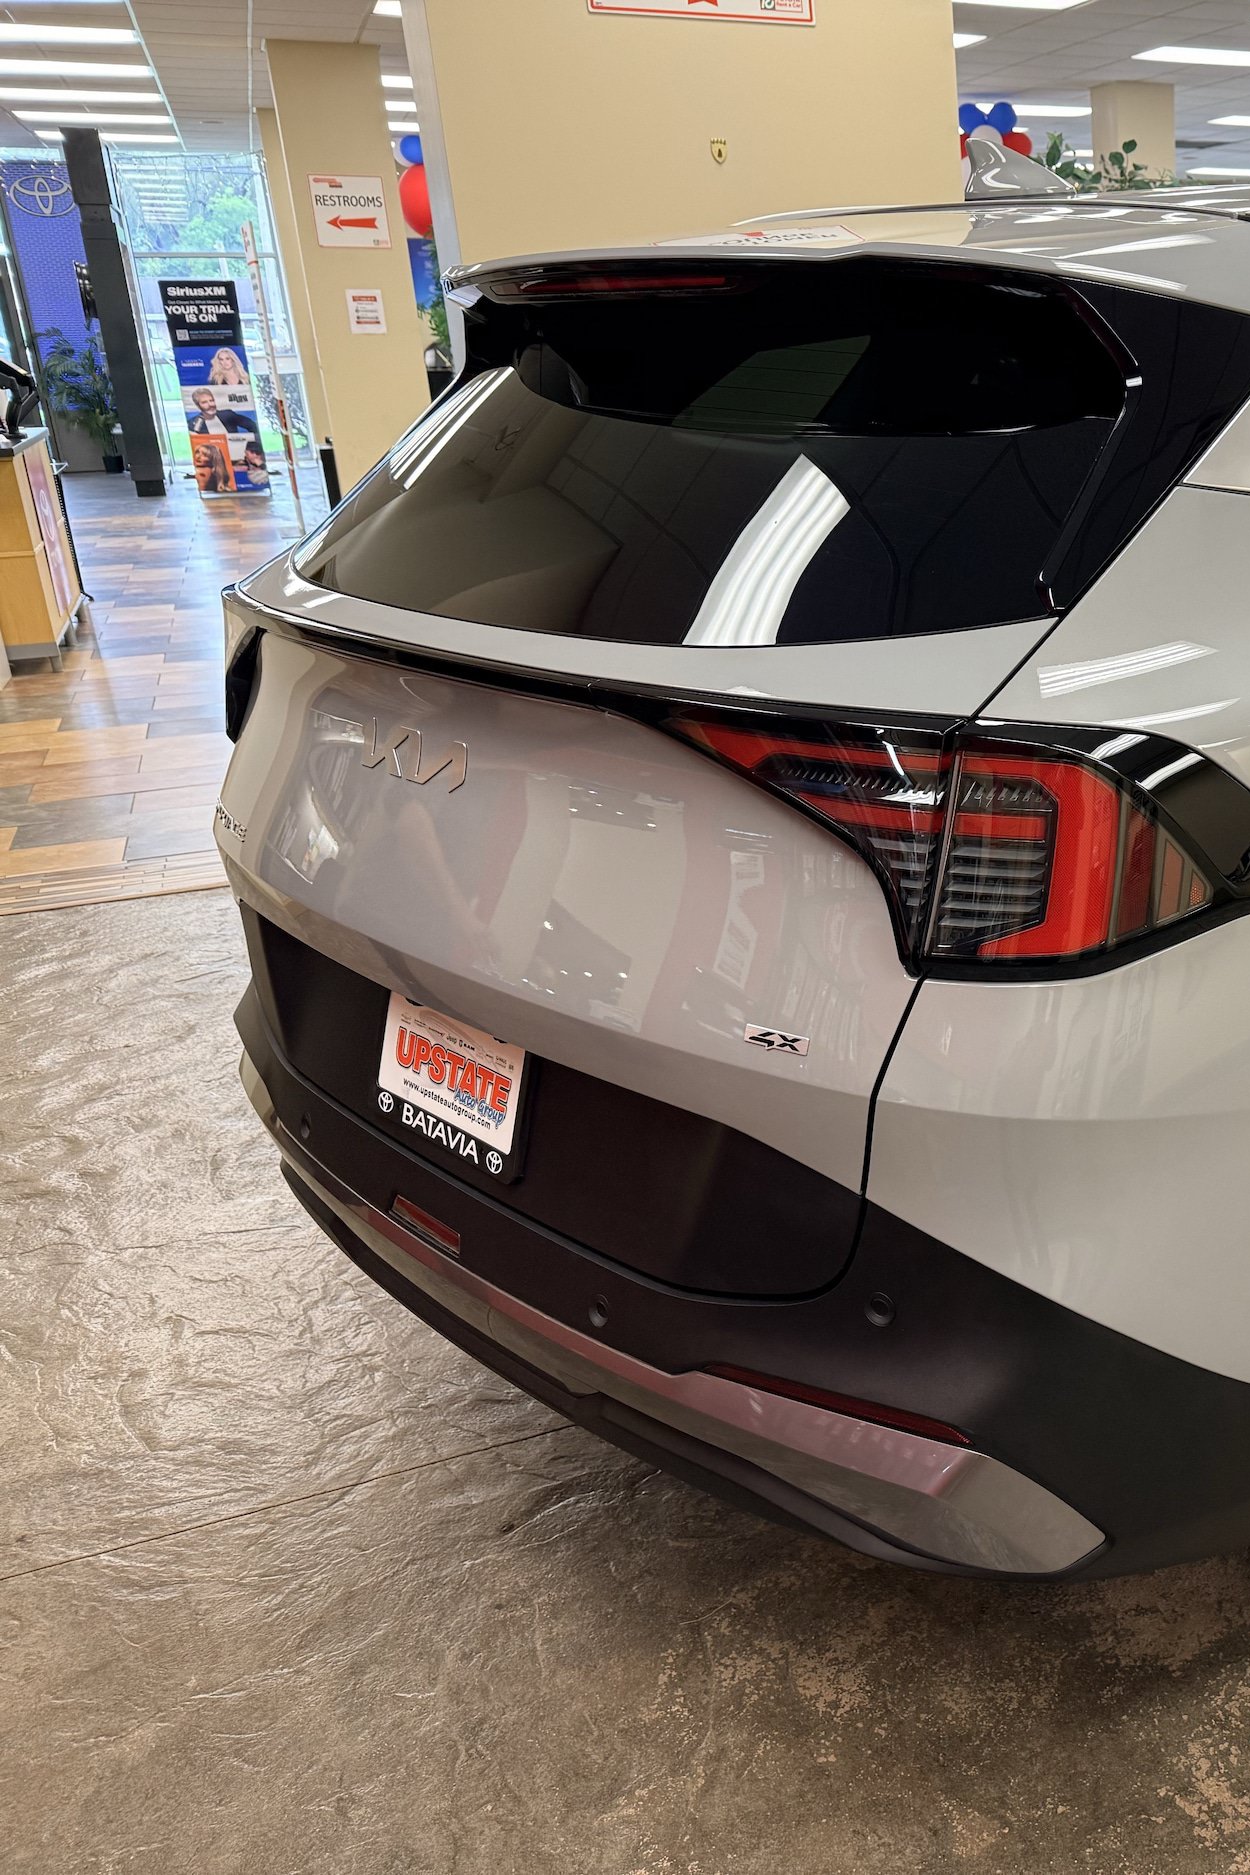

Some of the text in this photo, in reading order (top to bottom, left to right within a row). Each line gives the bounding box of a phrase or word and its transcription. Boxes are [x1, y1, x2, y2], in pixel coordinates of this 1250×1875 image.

[314, 194, 383, 208] RESTROOMS
[166, 286, 226, 296] SiriusXM
[164, 304, 235, 314] YOUR TRIAL
[185, 313, 218, 323] IS ON
[396, 1025, 512, 1115] UPSTATE
[402, 1077, 491, 1130] www.upstateautogroup.com
[454, 1087, 506, 1130] Auto Group
[401, 1103, 479, 1164] BATAVIA
